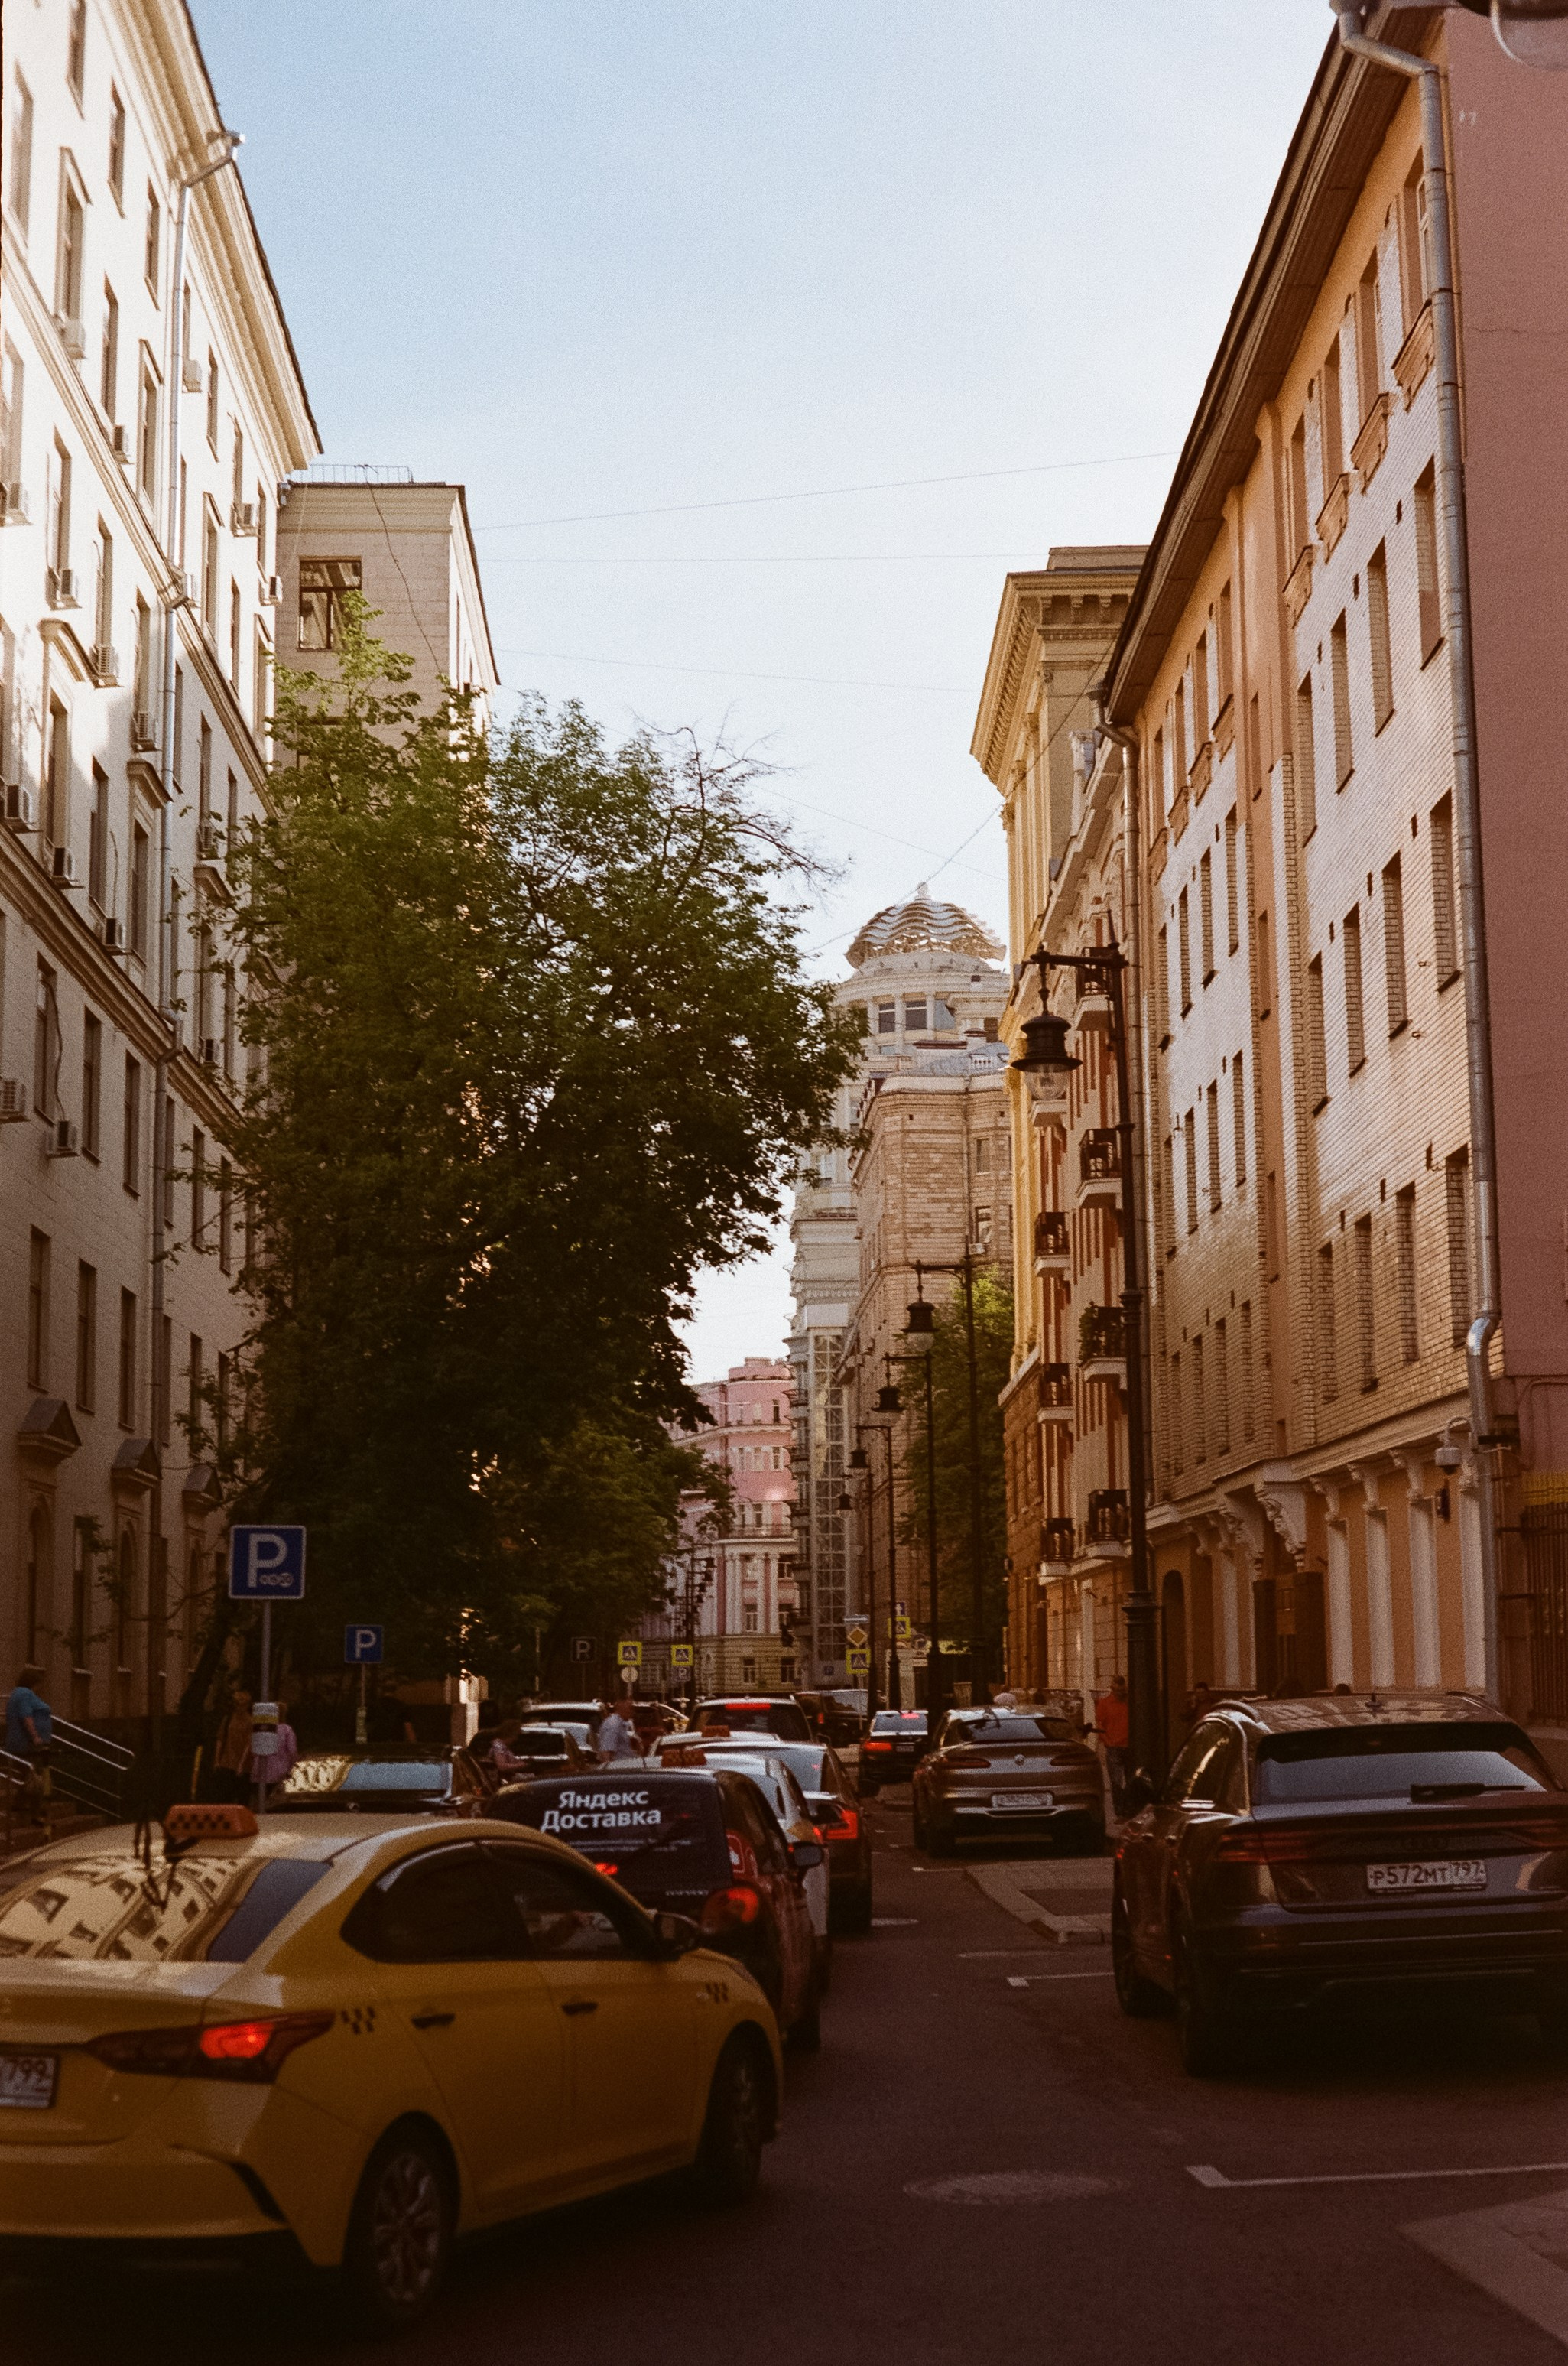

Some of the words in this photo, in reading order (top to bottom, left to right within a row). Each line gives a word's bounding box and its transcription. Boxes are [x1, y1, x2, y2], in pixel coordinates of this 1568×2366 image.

[247, 1532, 288, 1588] P
[355, 1629, 377, 1659] P
[678, 1668, 687, 1679] P
[558, 1790, 649, 1810] Яндекс
[541, 1809, 661, 1834] Доставка
